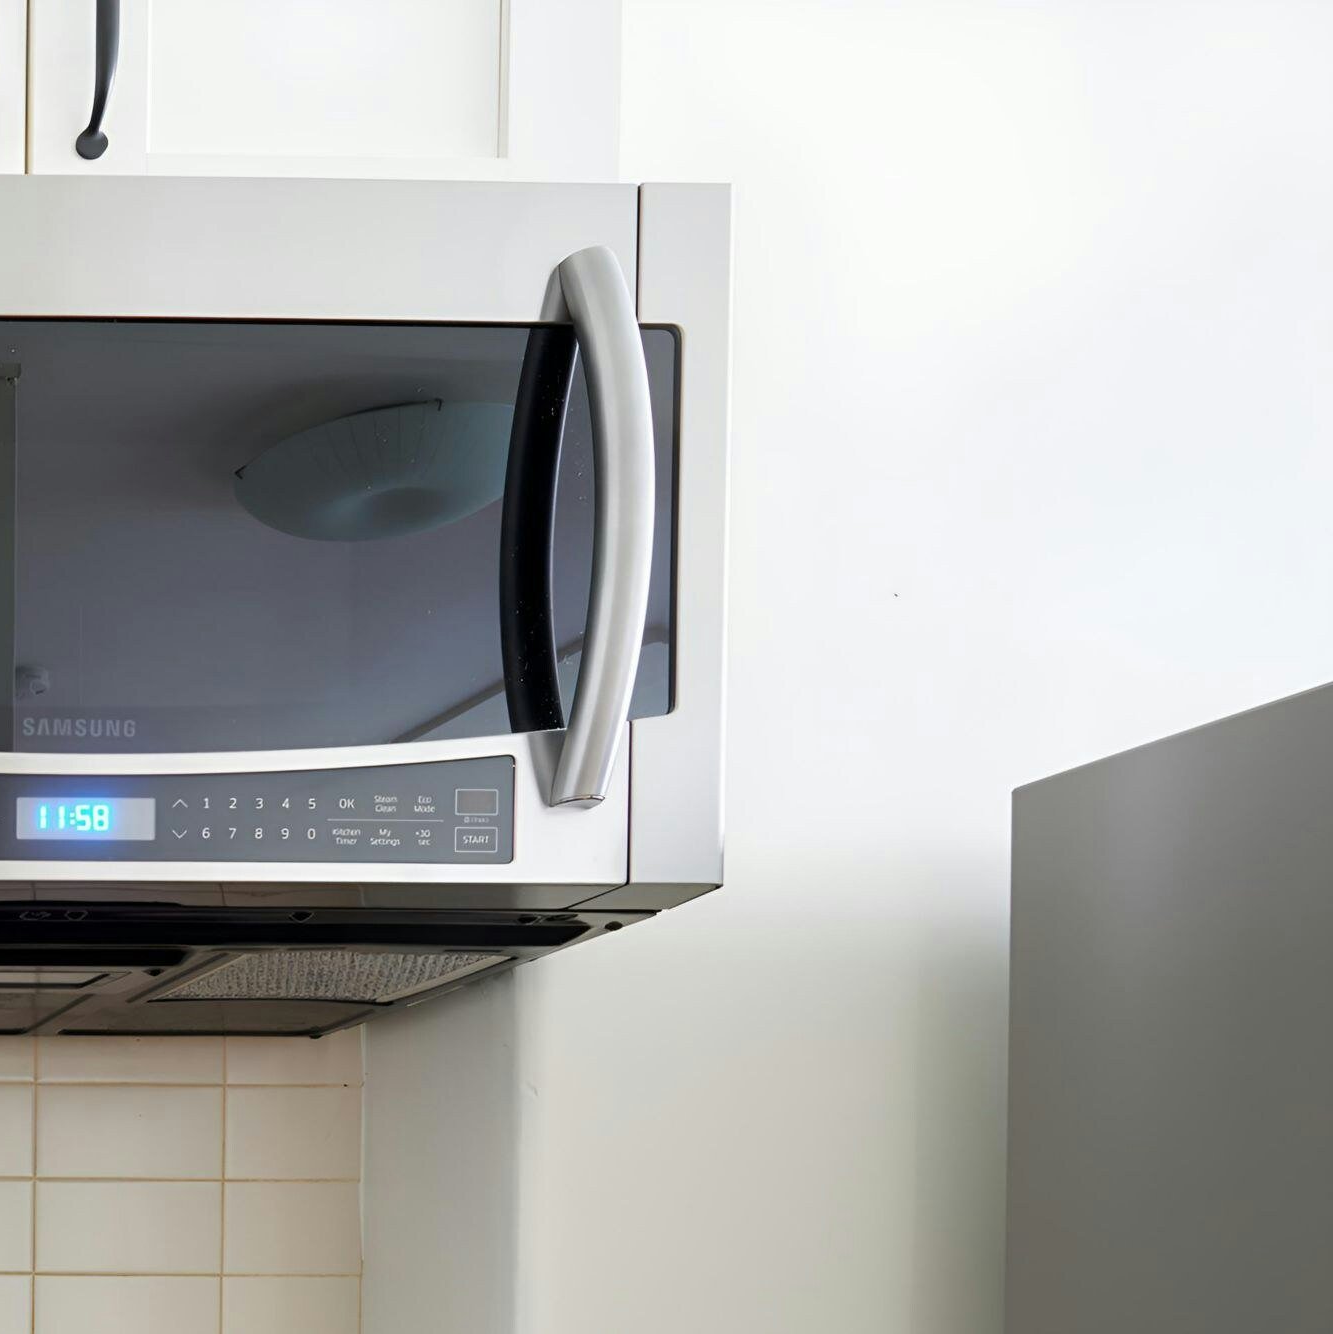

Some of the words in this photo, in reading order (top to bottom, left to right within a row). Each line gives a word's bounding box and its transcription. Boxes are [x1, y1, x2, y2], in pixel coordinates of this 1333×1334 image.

[22, 717, 136, 738] SAMSUNG
[202, 798, 210, 809] 1
[228, 797, 238, 809] 2
[255, 797, 264, 809] 3
[282, 797, 291, 809] 4
[308, 798, 317, 810] 5
[339, 798, 356, 809] OK
[38, 804, 110, 832] 11:58
[201, 827, 211, 839] 6
[228, 827, 237, 839] 7
[254, 827, 264, 839] 8
[281, 827, 290, 839] 9
[307, 828, 317, 840] 0
[463, 835, 490, 845] START
